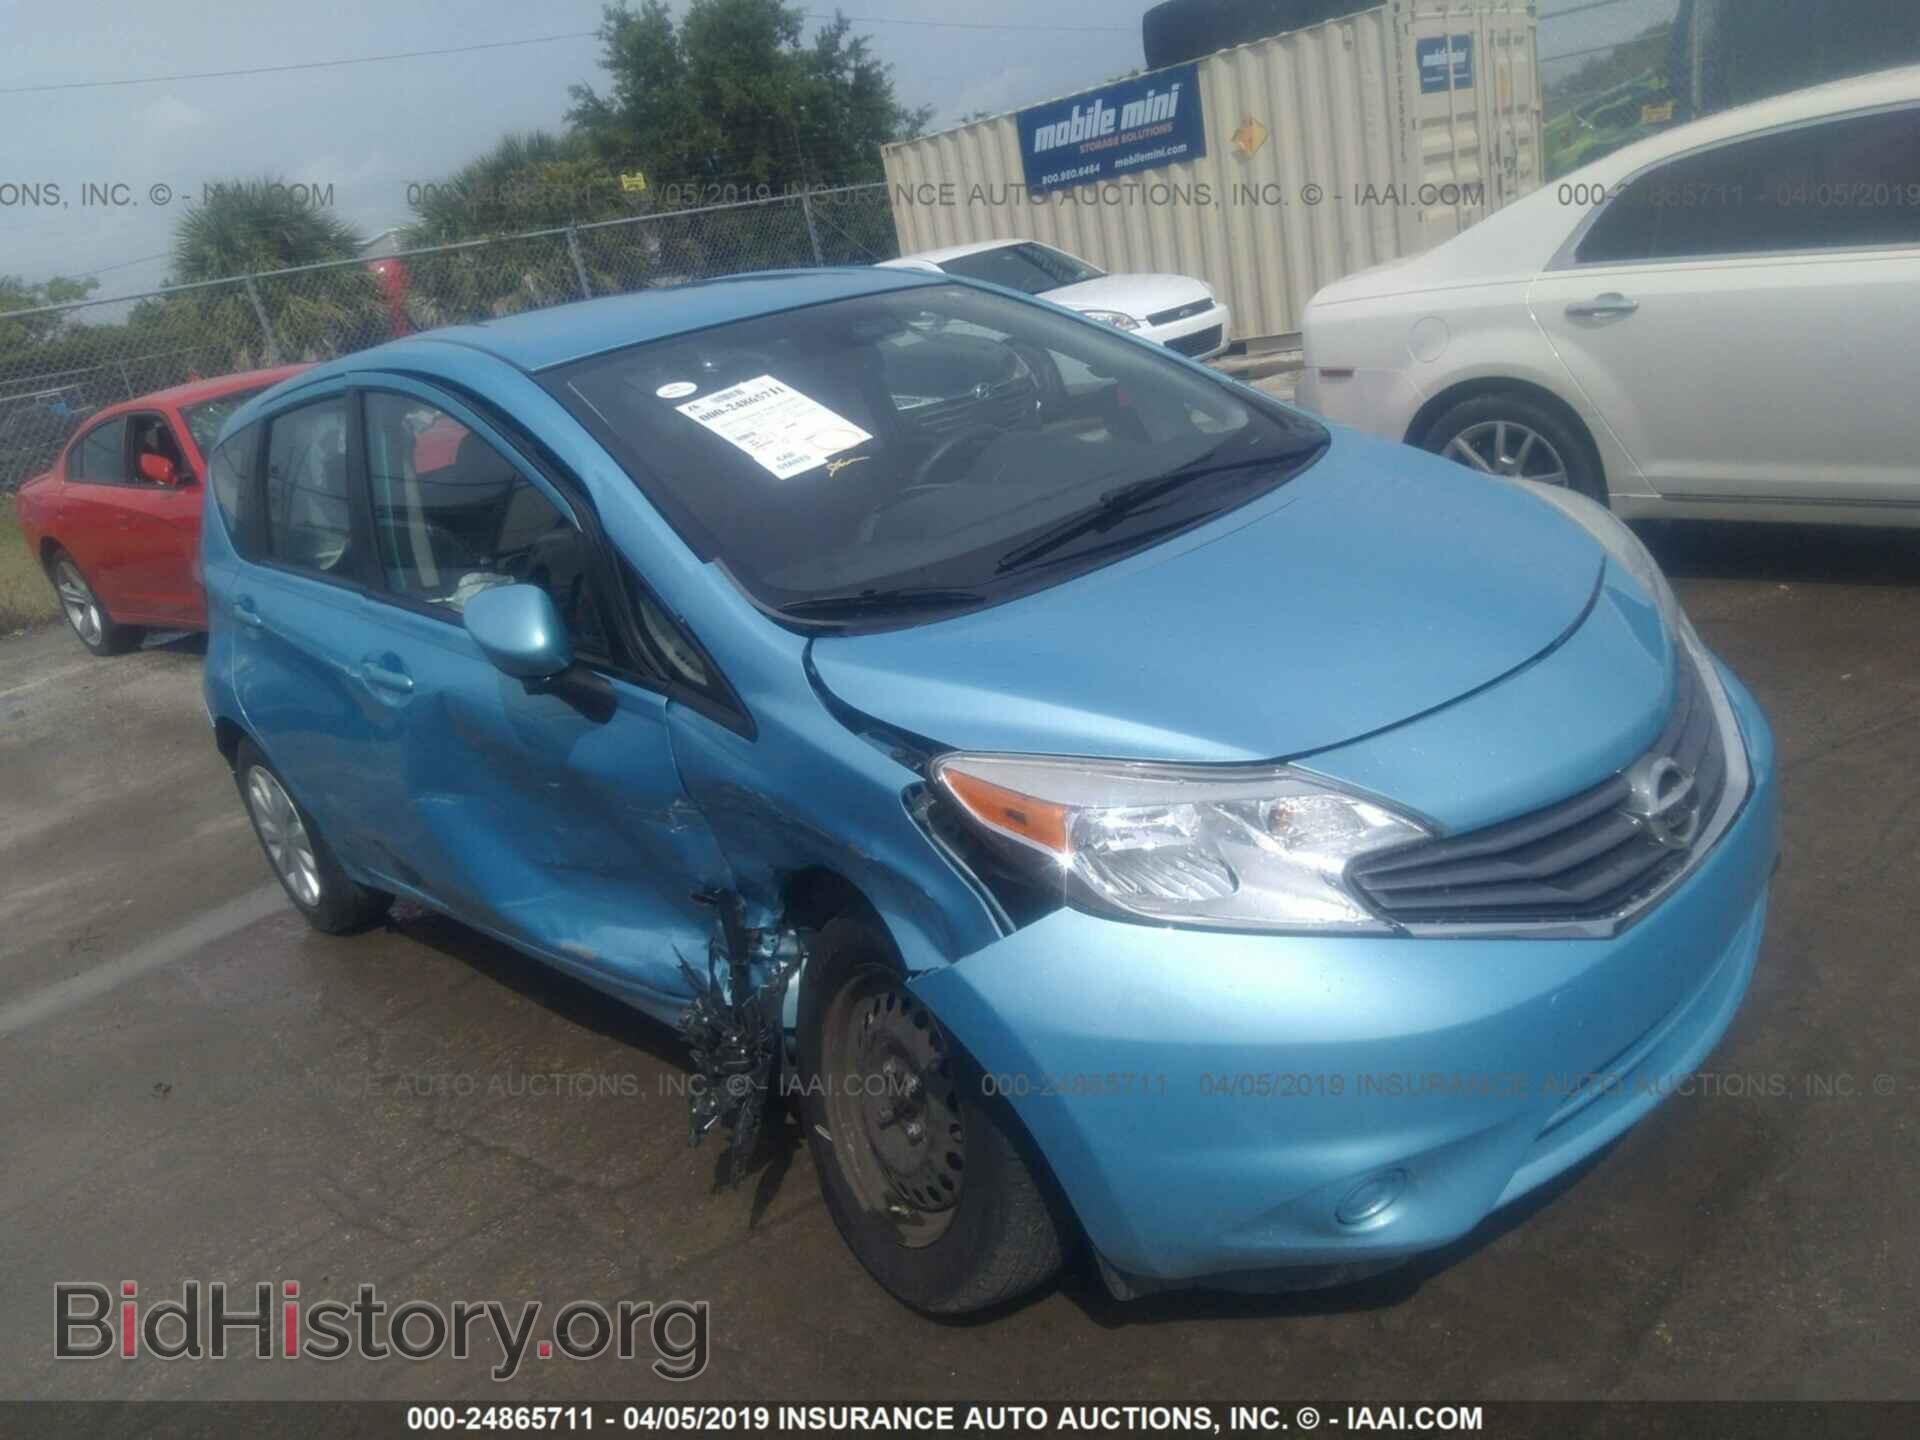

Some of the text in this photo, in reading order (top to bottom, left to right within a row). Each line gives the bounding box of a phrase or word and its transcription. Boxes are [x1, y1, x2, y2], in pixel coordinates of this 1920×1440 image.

[1035, 83, 1180, 152] mobile mini
[1114, 143, 1188, 168] mobilemini.com
